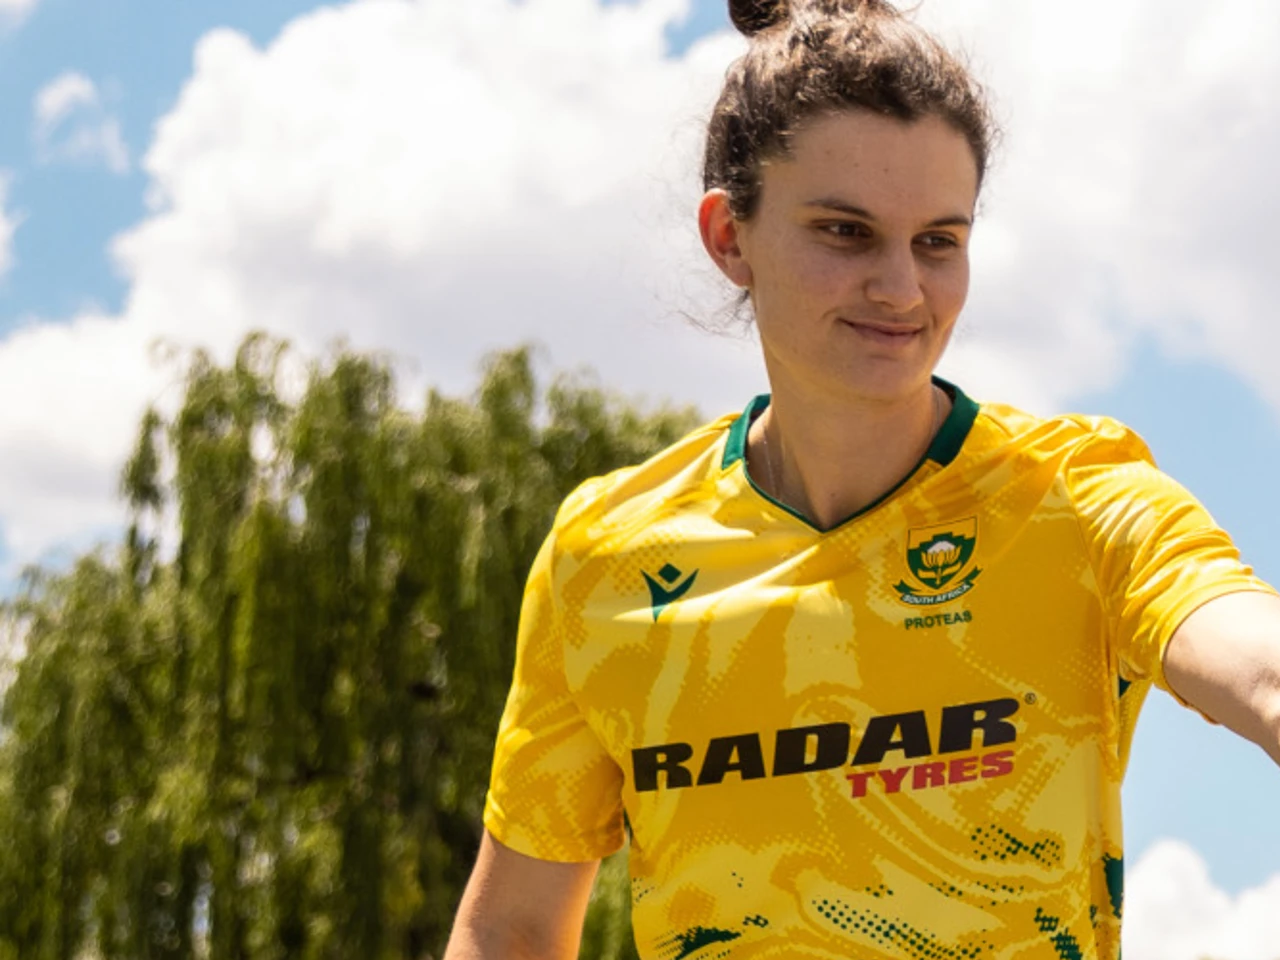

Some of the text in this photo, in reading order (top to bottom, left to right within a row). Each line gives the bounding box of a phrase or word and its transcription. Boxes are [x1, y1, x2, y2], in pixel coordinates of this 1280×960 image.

[902, 593, 935, 605] SOUTH
[904, 610, 972, 630] PROTEAS
[631, 697, 1020, 792] RADAR
[846, 750, 1015, 798] TYRES
